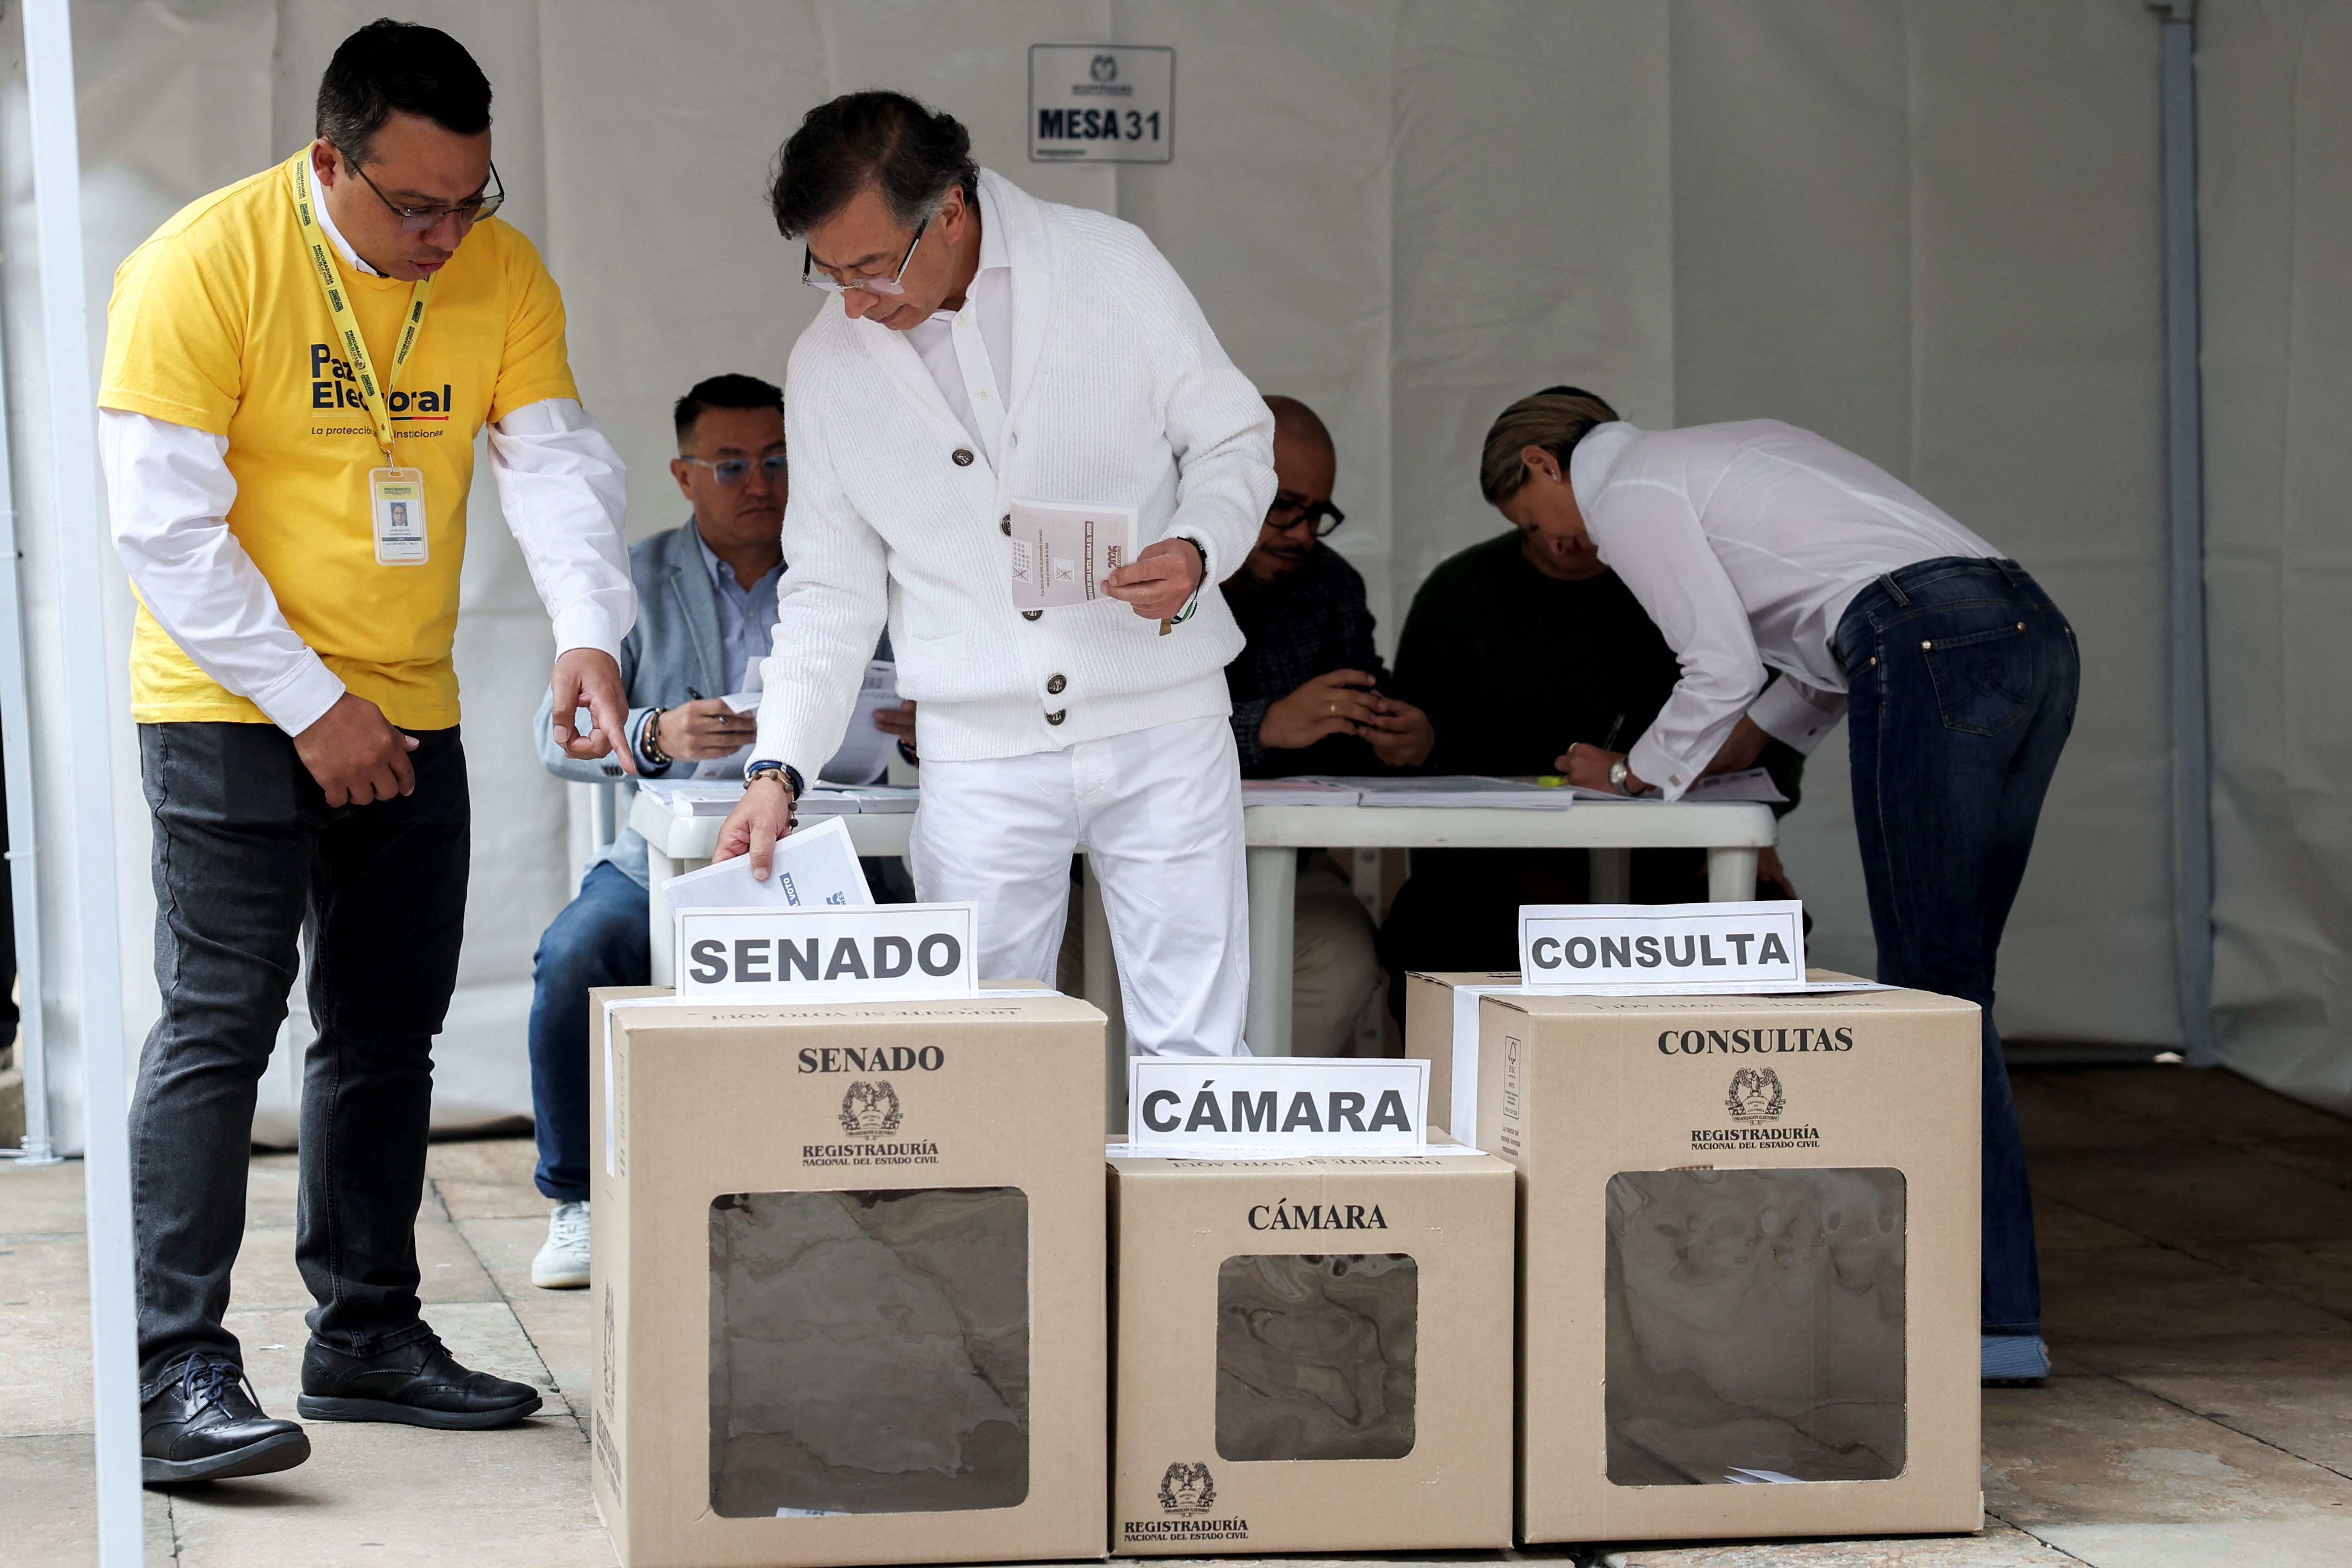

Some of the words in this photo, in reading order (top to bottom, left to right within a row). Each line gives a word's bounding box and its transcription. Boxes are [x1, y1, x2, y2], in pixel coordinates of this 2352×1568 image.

[1039, 109, 1120, 139] MESA
[1125, 110, 1160, 141] 31
[316, 244, 335, 285] PROCURADURÍA
[311, 344, 356, 382] Paz
[783, 877, 796, 901] VOTO
[689, 933, 961, 984] SENADO
[1531, 933, 1791, 969] CONSULTA
[1658, 1026, 1853, 1056] CONSULTAS
[798, 1045, 944, 1074] SENADO
[1141, 1079, 1413, 1133] CÁMARA
[1691, 1123, 1819, 1141] REGISTRADURÍA
[803, 1139, 939, 1157] REGISTRADURÍA
[1691, 1142, 1736, 1150] NACIONAL
[803, 1158, 851, 1167] NACIONAL
[875, 1156, 912, 1165] ESTADO
[1232, 1160, 1295, 1168] VOTO
[1298, 1158, 1327, 1168] SU
[1331, 1157, 1443, 1168] DEPOSITE
[1247, 1197, 1388, 1231] CÁMARA
[1124, 1516, 1248, 1533] REGISTRADURÍA
